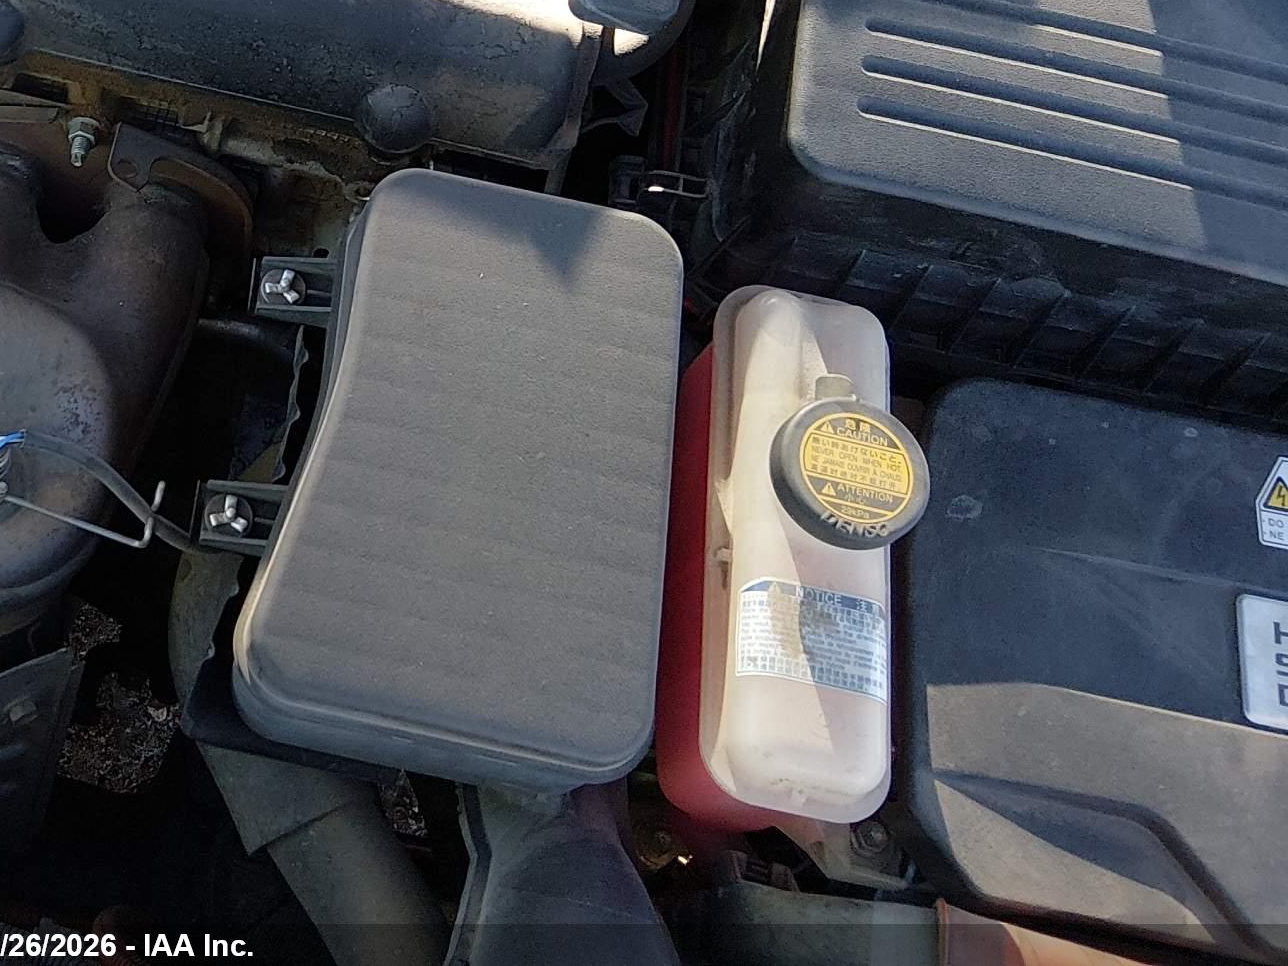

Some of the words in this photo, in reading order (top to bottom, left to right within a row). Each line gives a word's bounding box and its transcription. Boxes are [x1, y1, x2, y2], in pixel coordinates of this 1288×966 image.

[836, 426, 888, 446] CAUTION
[839, 452, 858, 463] OPEN
[861, 458, 882, 469] WHEN
[837, 483, 893, 503] ATTENTION
[1269, 530, 1285, 541] NE
[795, 585, 842, 605] NOTICE
